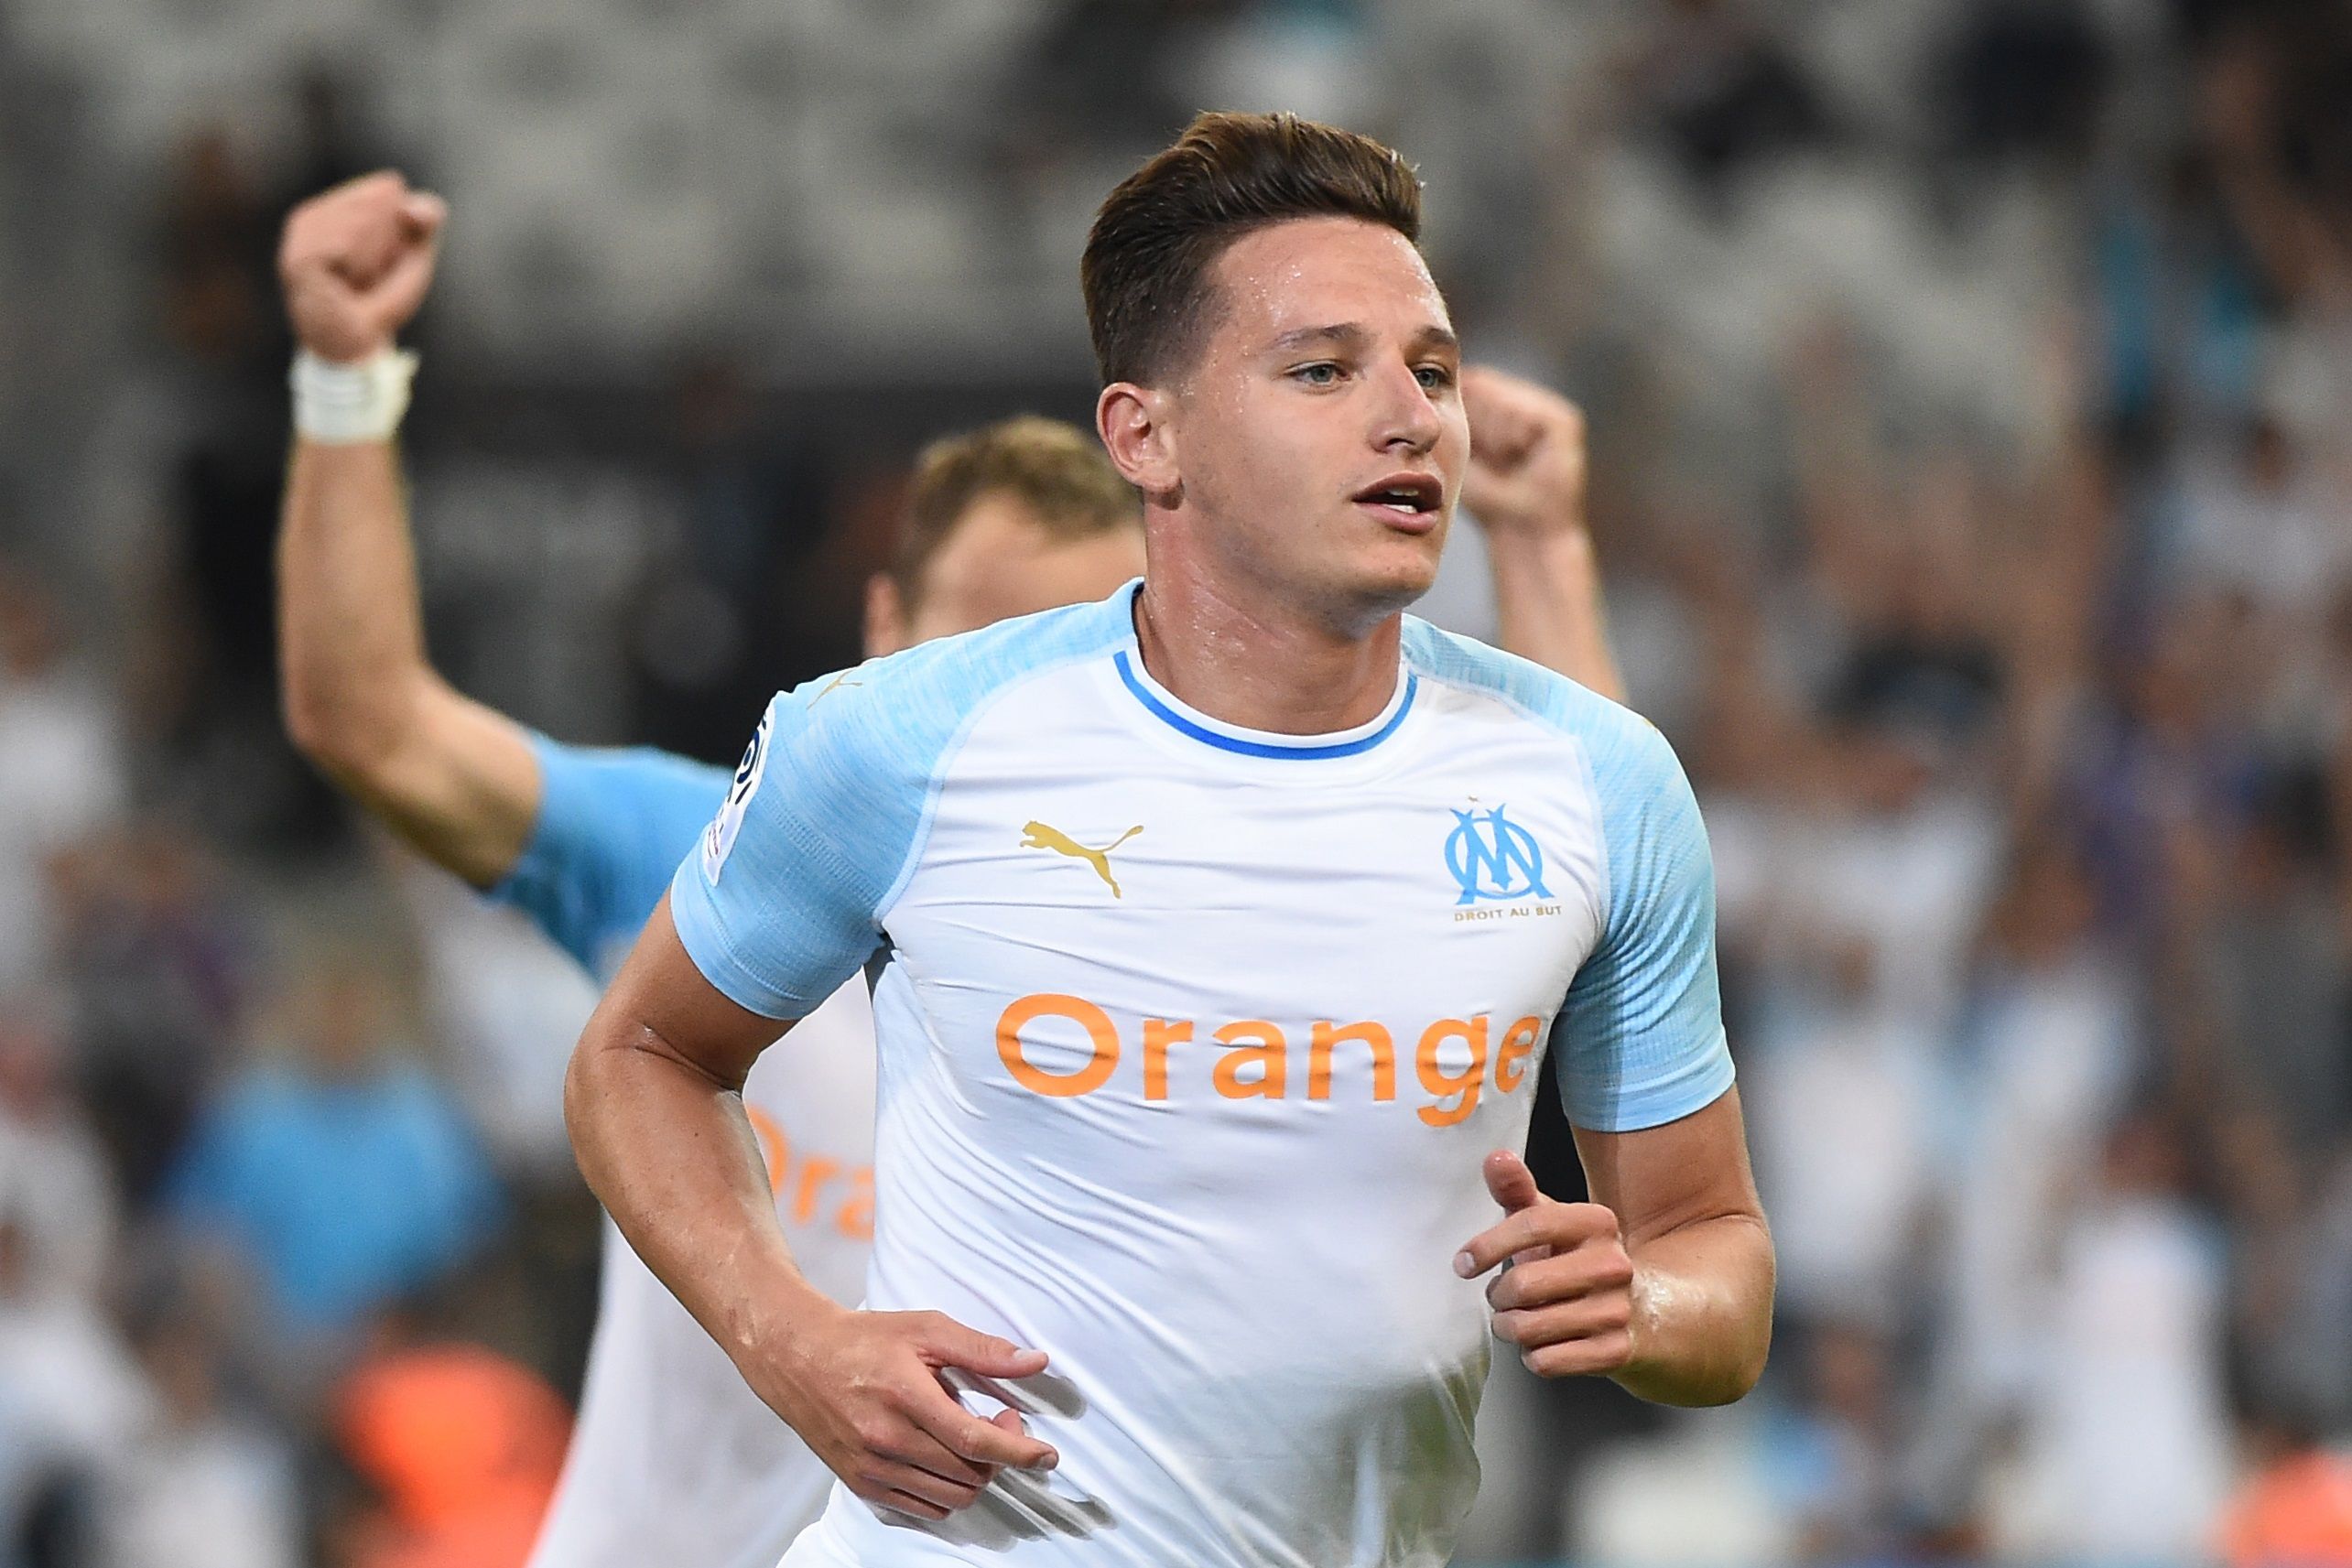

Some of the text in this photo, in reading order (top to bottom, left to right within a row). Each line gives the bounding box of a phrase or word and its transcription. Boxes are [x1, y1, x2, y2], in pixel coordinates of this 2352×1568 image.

[1454, 905, 1562, 922] DROIT AU BUT
[995, 992, 1542, 1127] Orange
